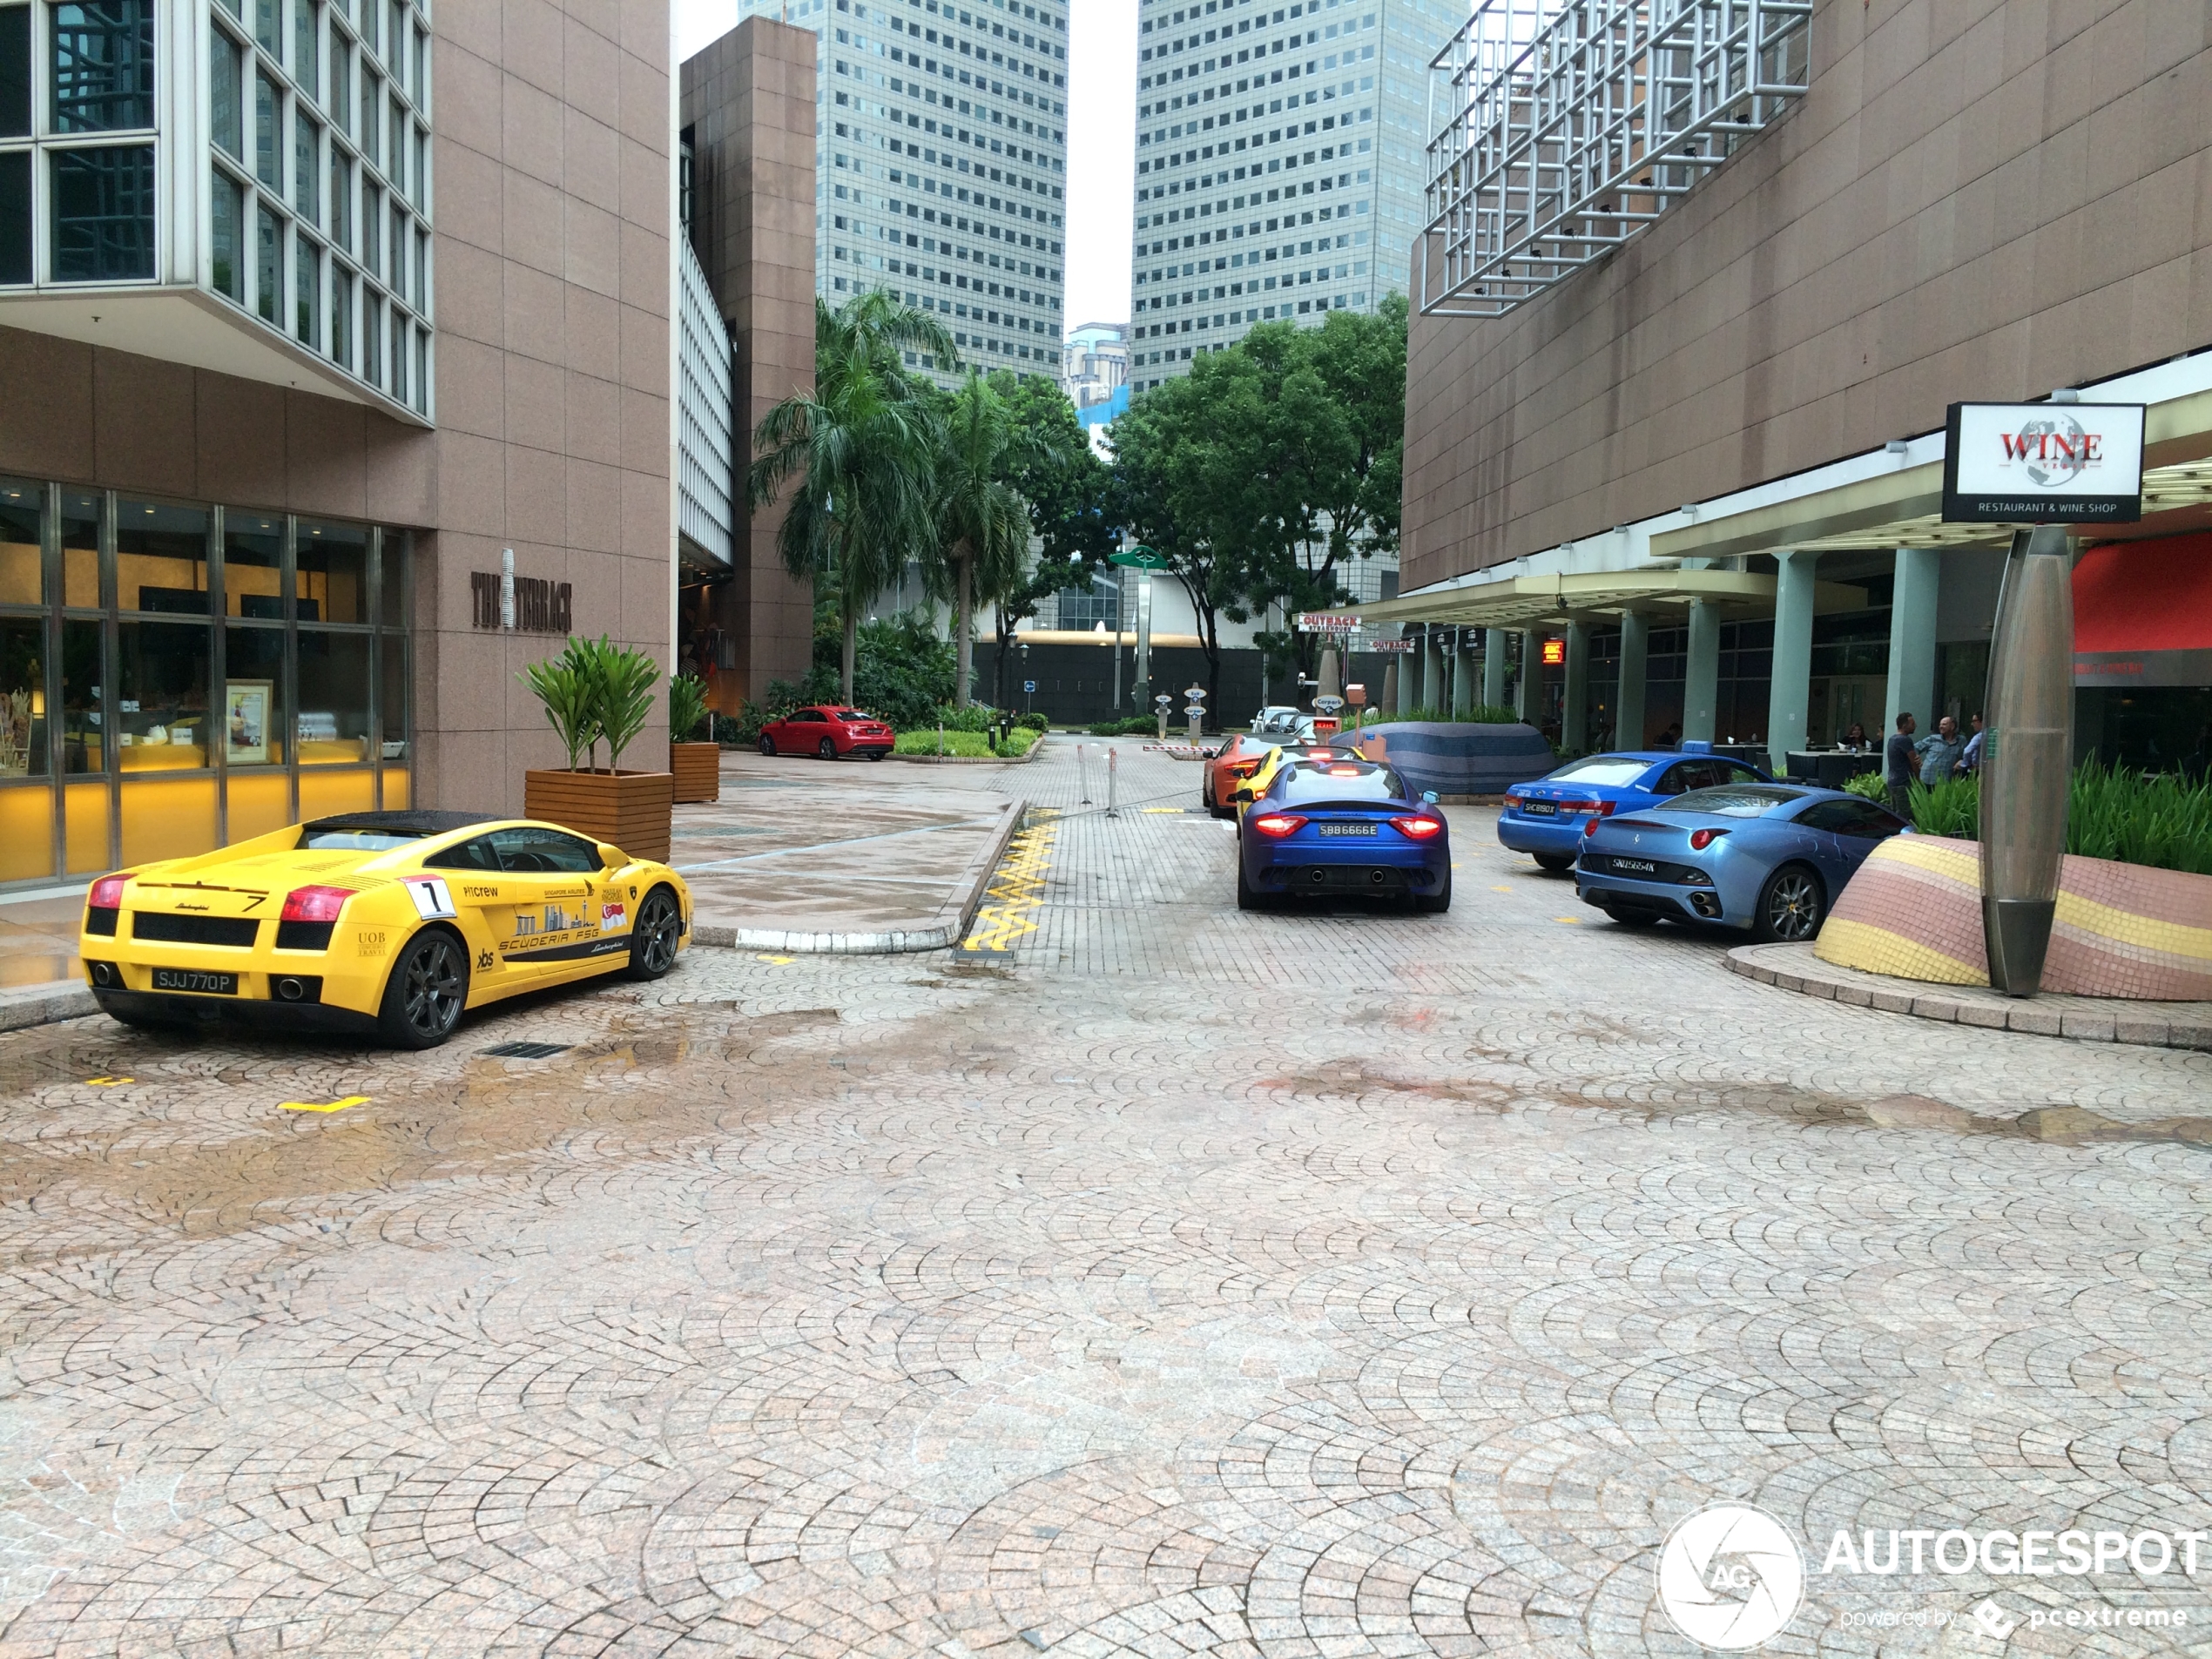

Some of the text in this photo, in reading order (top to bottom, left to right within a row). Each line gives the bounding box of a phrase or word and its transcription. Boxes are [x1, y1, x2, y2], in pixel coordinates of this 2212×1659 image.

[2000, 433, 2103, 462] WINE
[1978, 502, 2117, 513] RESTAURANT & WINE SHOP
[1304, 615, 1358, 626] OUTBACK
[1320, 826, 1378, 835] SBB6666E
[241, 895, 267, 913] 7
[358, 932, 386, 944] UOB
[498, 927, 600, 950] SCUDERIA FSG
[158, 971, 230, 991] SJJ770P
